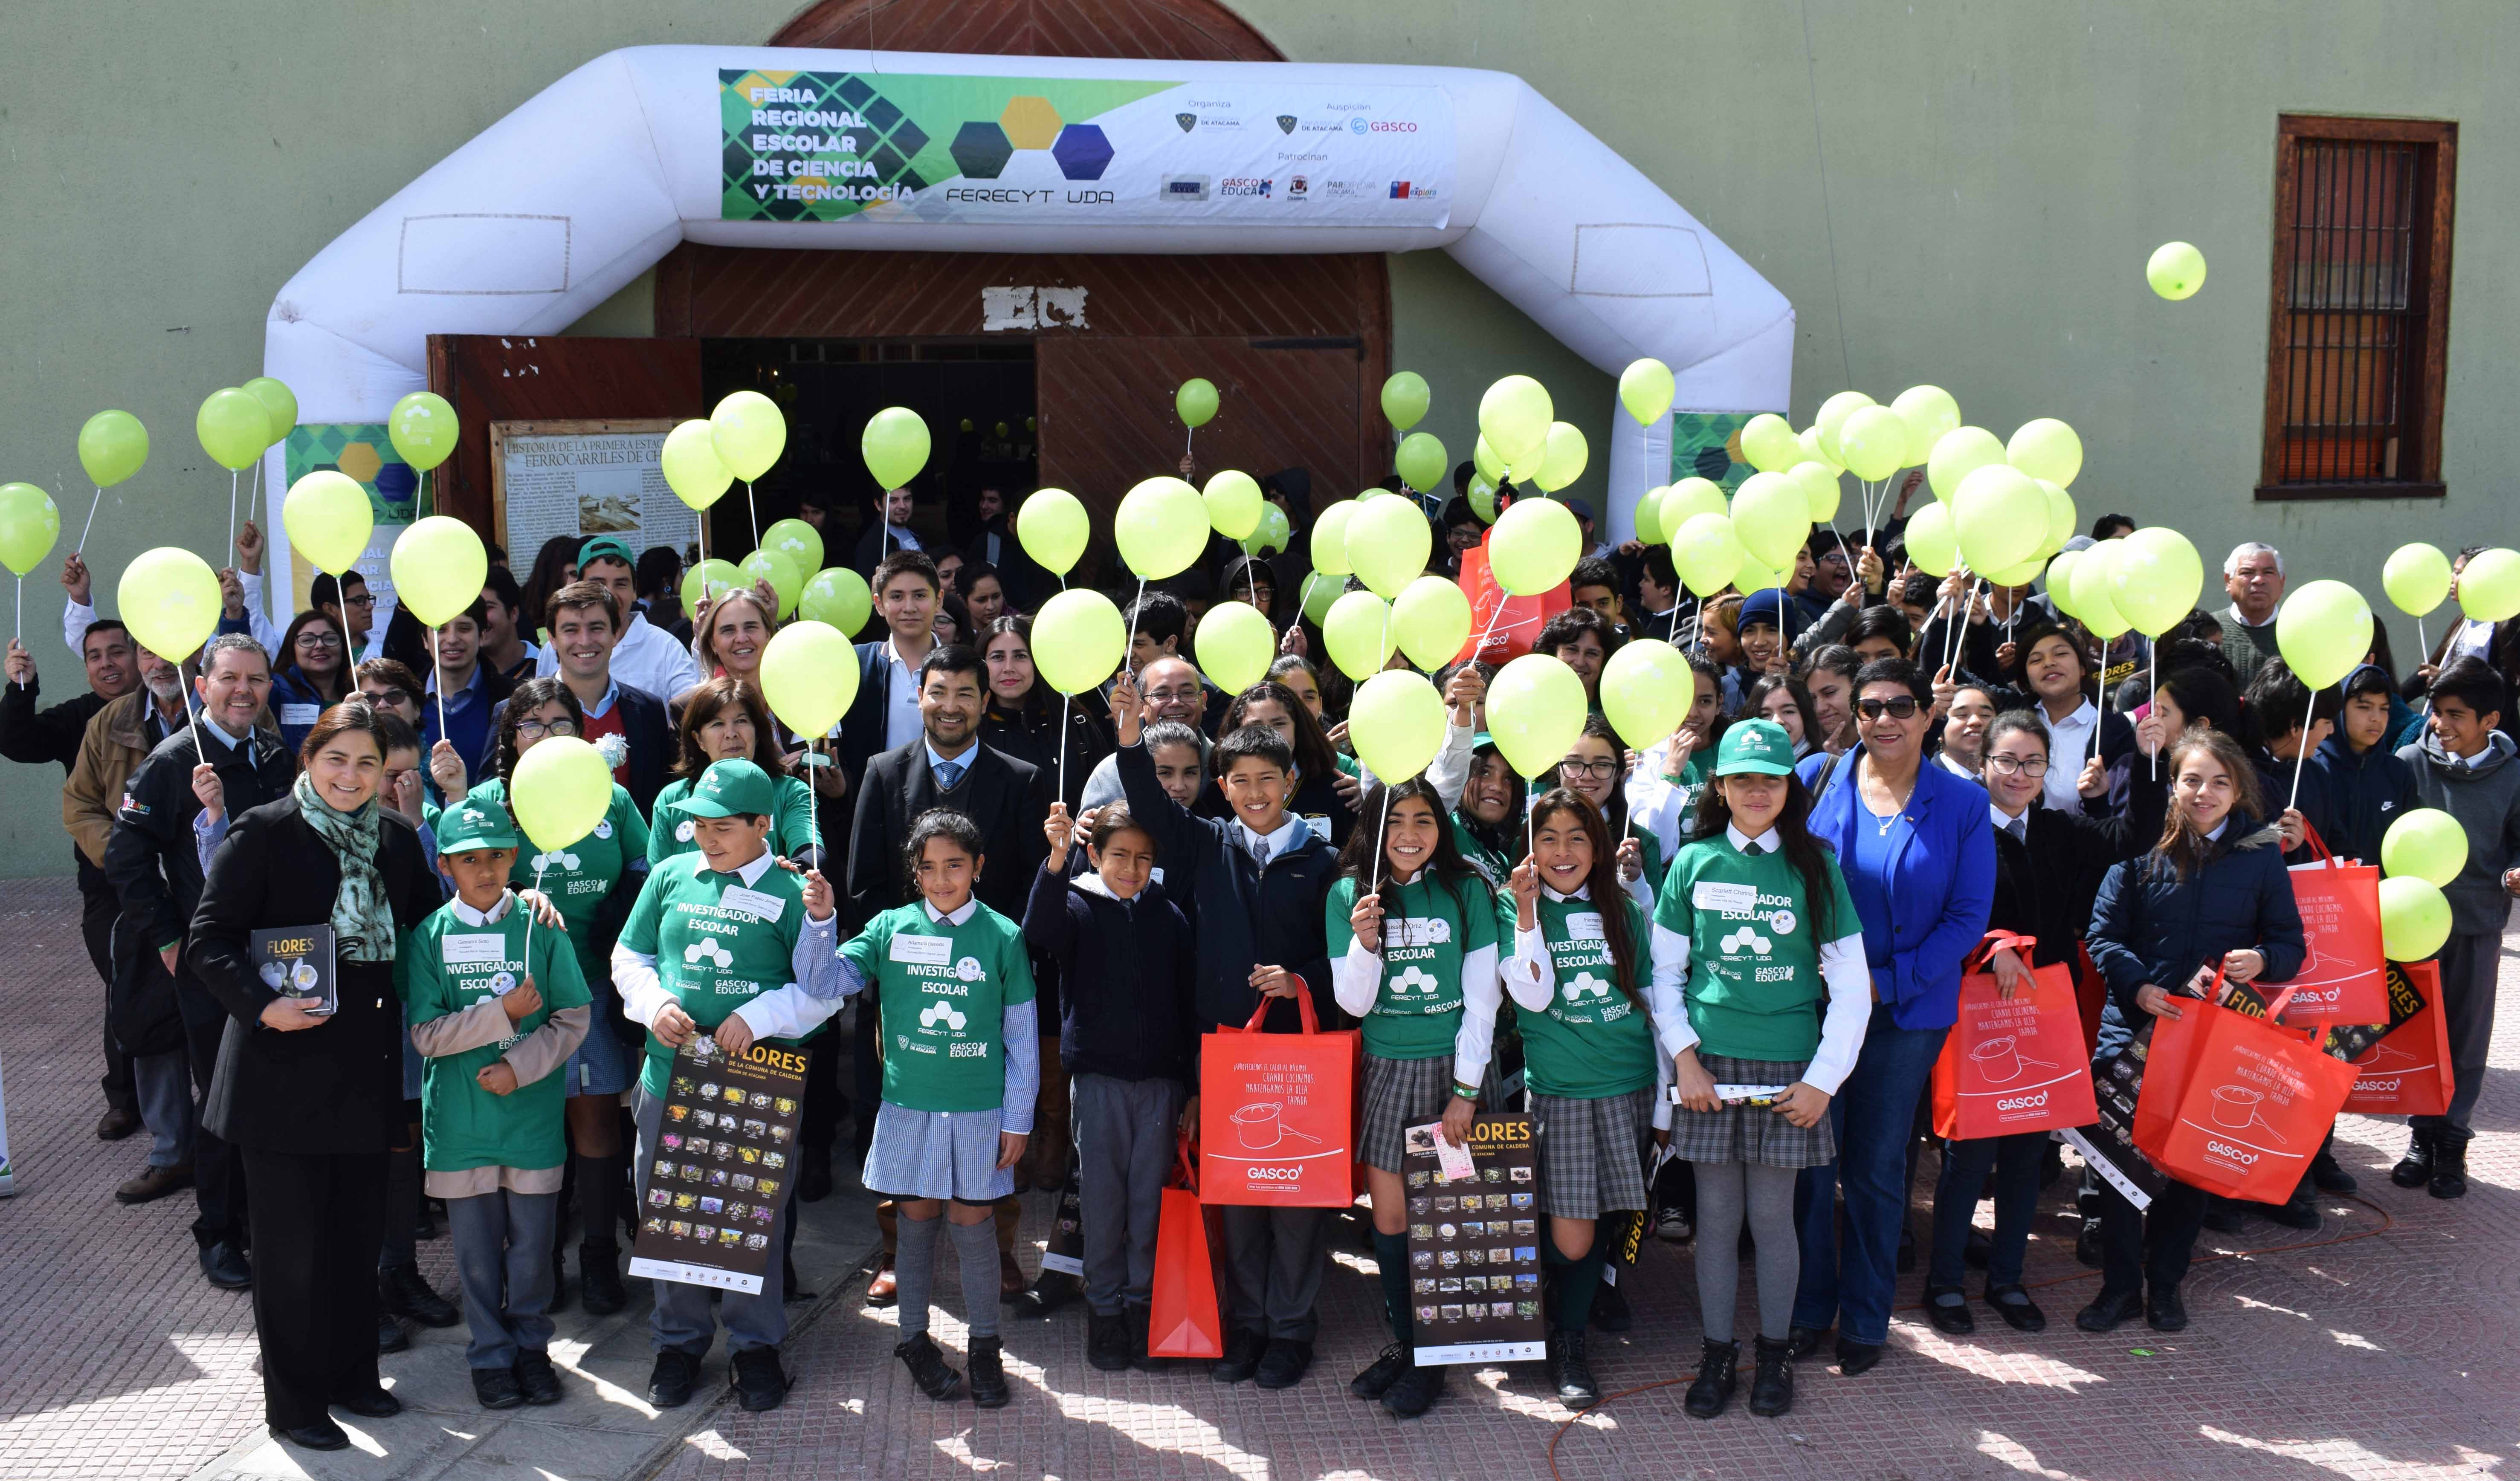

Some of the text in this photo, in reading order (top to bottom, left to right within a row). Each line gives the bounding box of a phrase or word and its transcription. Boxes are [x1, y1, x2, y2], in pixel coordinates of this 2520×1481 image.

[751, 87, 817, 103] FERIA
[1188, 100, 1231, 109] Organiza
[1327, 103, 1371, 112] Auspician
[752, 110, 866, 128] REGIONAL
[753, 134, 857, 153] ESCOLAR
[1278, 153, 1328, 162] Patrocinan
[754, 159, 879, 178] DE CIENCIA
[1222, 178, 1258, 187] GASCO
[755, 181, 915, 202] Y TECNOLOGÍA
[947, 188, 1114, 205] FERECYT UDA
[1221, 187, 1257, 196] EDUCA
[507, 438, 664, 454] HISTORIA DE LA PRIMERA ESTAC
[525, 451, 624, 468] FERROCARRILES
[628, 451, 643, 463] DE
[567, 879, 597, 888] GASCO
[568, 886, 596, 894] EDUCA
[677, 902, 759, 924] INVESTIGADOR
[1721, 910, 1773, 921] ESCOLAR
[688, 918, 739, 936] ESCOLAR
[267, 938, 314, 954] FLORES
[1547, 940, 1607, 952] VESTIGAD
[1387, 948, 1435, 962] ESCOLAR
[1556, 955, 1604, 968] ESCOLAR
[446, 961, 523, 975] NVESTIGADOR
[682, 964, 713, 972] FERECYT
[907, 965, 986, 981] INVESTIGR
[1755, 967, 1784, 975] GASCO
[461, 978, 491, 989] ESCOL
[715, 979, 747, 987] GASCO
[1755, 974, 1784, 982] EDUCA
[715, 986, 748, 994] EDUCA
[922, 982, 968, 996] ESCOLAR
[2386, 960, 2418, 1013] ORES
[1567, 999, 1596, 1007] FRECYT
[2289, 990, 2338, 1004] GASCO
[1424, 1002, 1453, 1013] GASCO
[918, 1027, 948, 1036] FERECYT
[910, 1041, 937, 1050] UNIVERSIDAD
[731, 1047, 806, 1073] LORES
[745, 1064, 768, 1073] COMUNA
[779, 1071, 802, 1081] CALDERA
[1263, 1073, 1315, 1084] CUANDO COCINEMOS,
[1246, 1083, 1308, 1094] MANTENGAMOS LA OLLA
[2351, 1081, 2397, 1091] GASCO
[1287, 1096, 1308, 1105] TAPADA
[1997, 1095, 2046, 1111] GASCO
[1467, 1121, 1530, 1142] LORES
[2207, 1140, 2253, 1165] GASCO
[1248, 1168, 1299, 1180] GASCO
[1626, 1211, 1644, 1264] ORES
